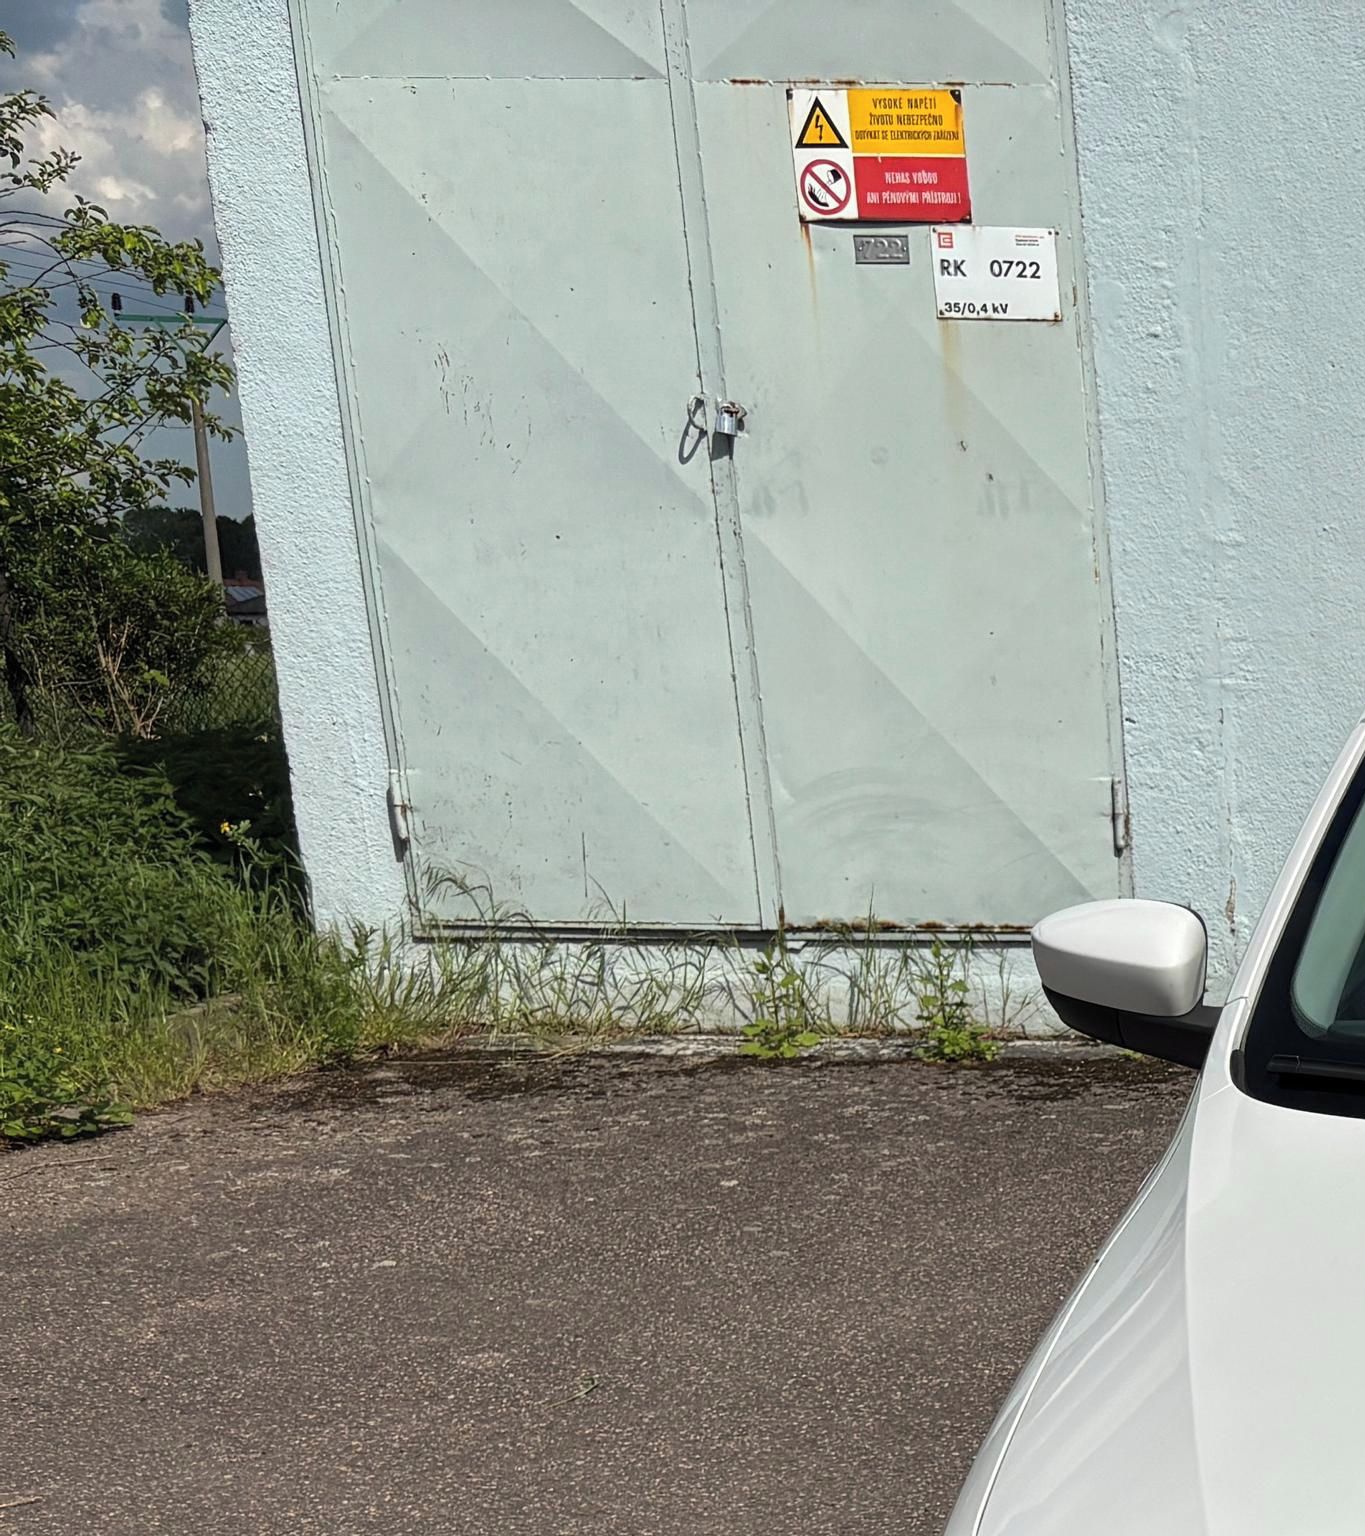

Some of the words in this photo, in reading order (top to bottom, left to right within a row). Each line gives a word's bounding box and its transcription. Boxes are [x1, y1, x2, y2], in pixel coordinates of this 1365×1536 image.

[872, 97, 902, 110] VYSOKÉ
[908, 96, 937, 110] NAPĚTÍ
[869, 112, 894, 126] ŽIVOTU
[897, 113, 943, 126] NEBEZPEČNO
[940, 259, 967, 277] RK
[990, 259, 1041, 279] 0722
[944, 302, 988, 316] 35/0,4
[992, 303, 1009, 314] kV
